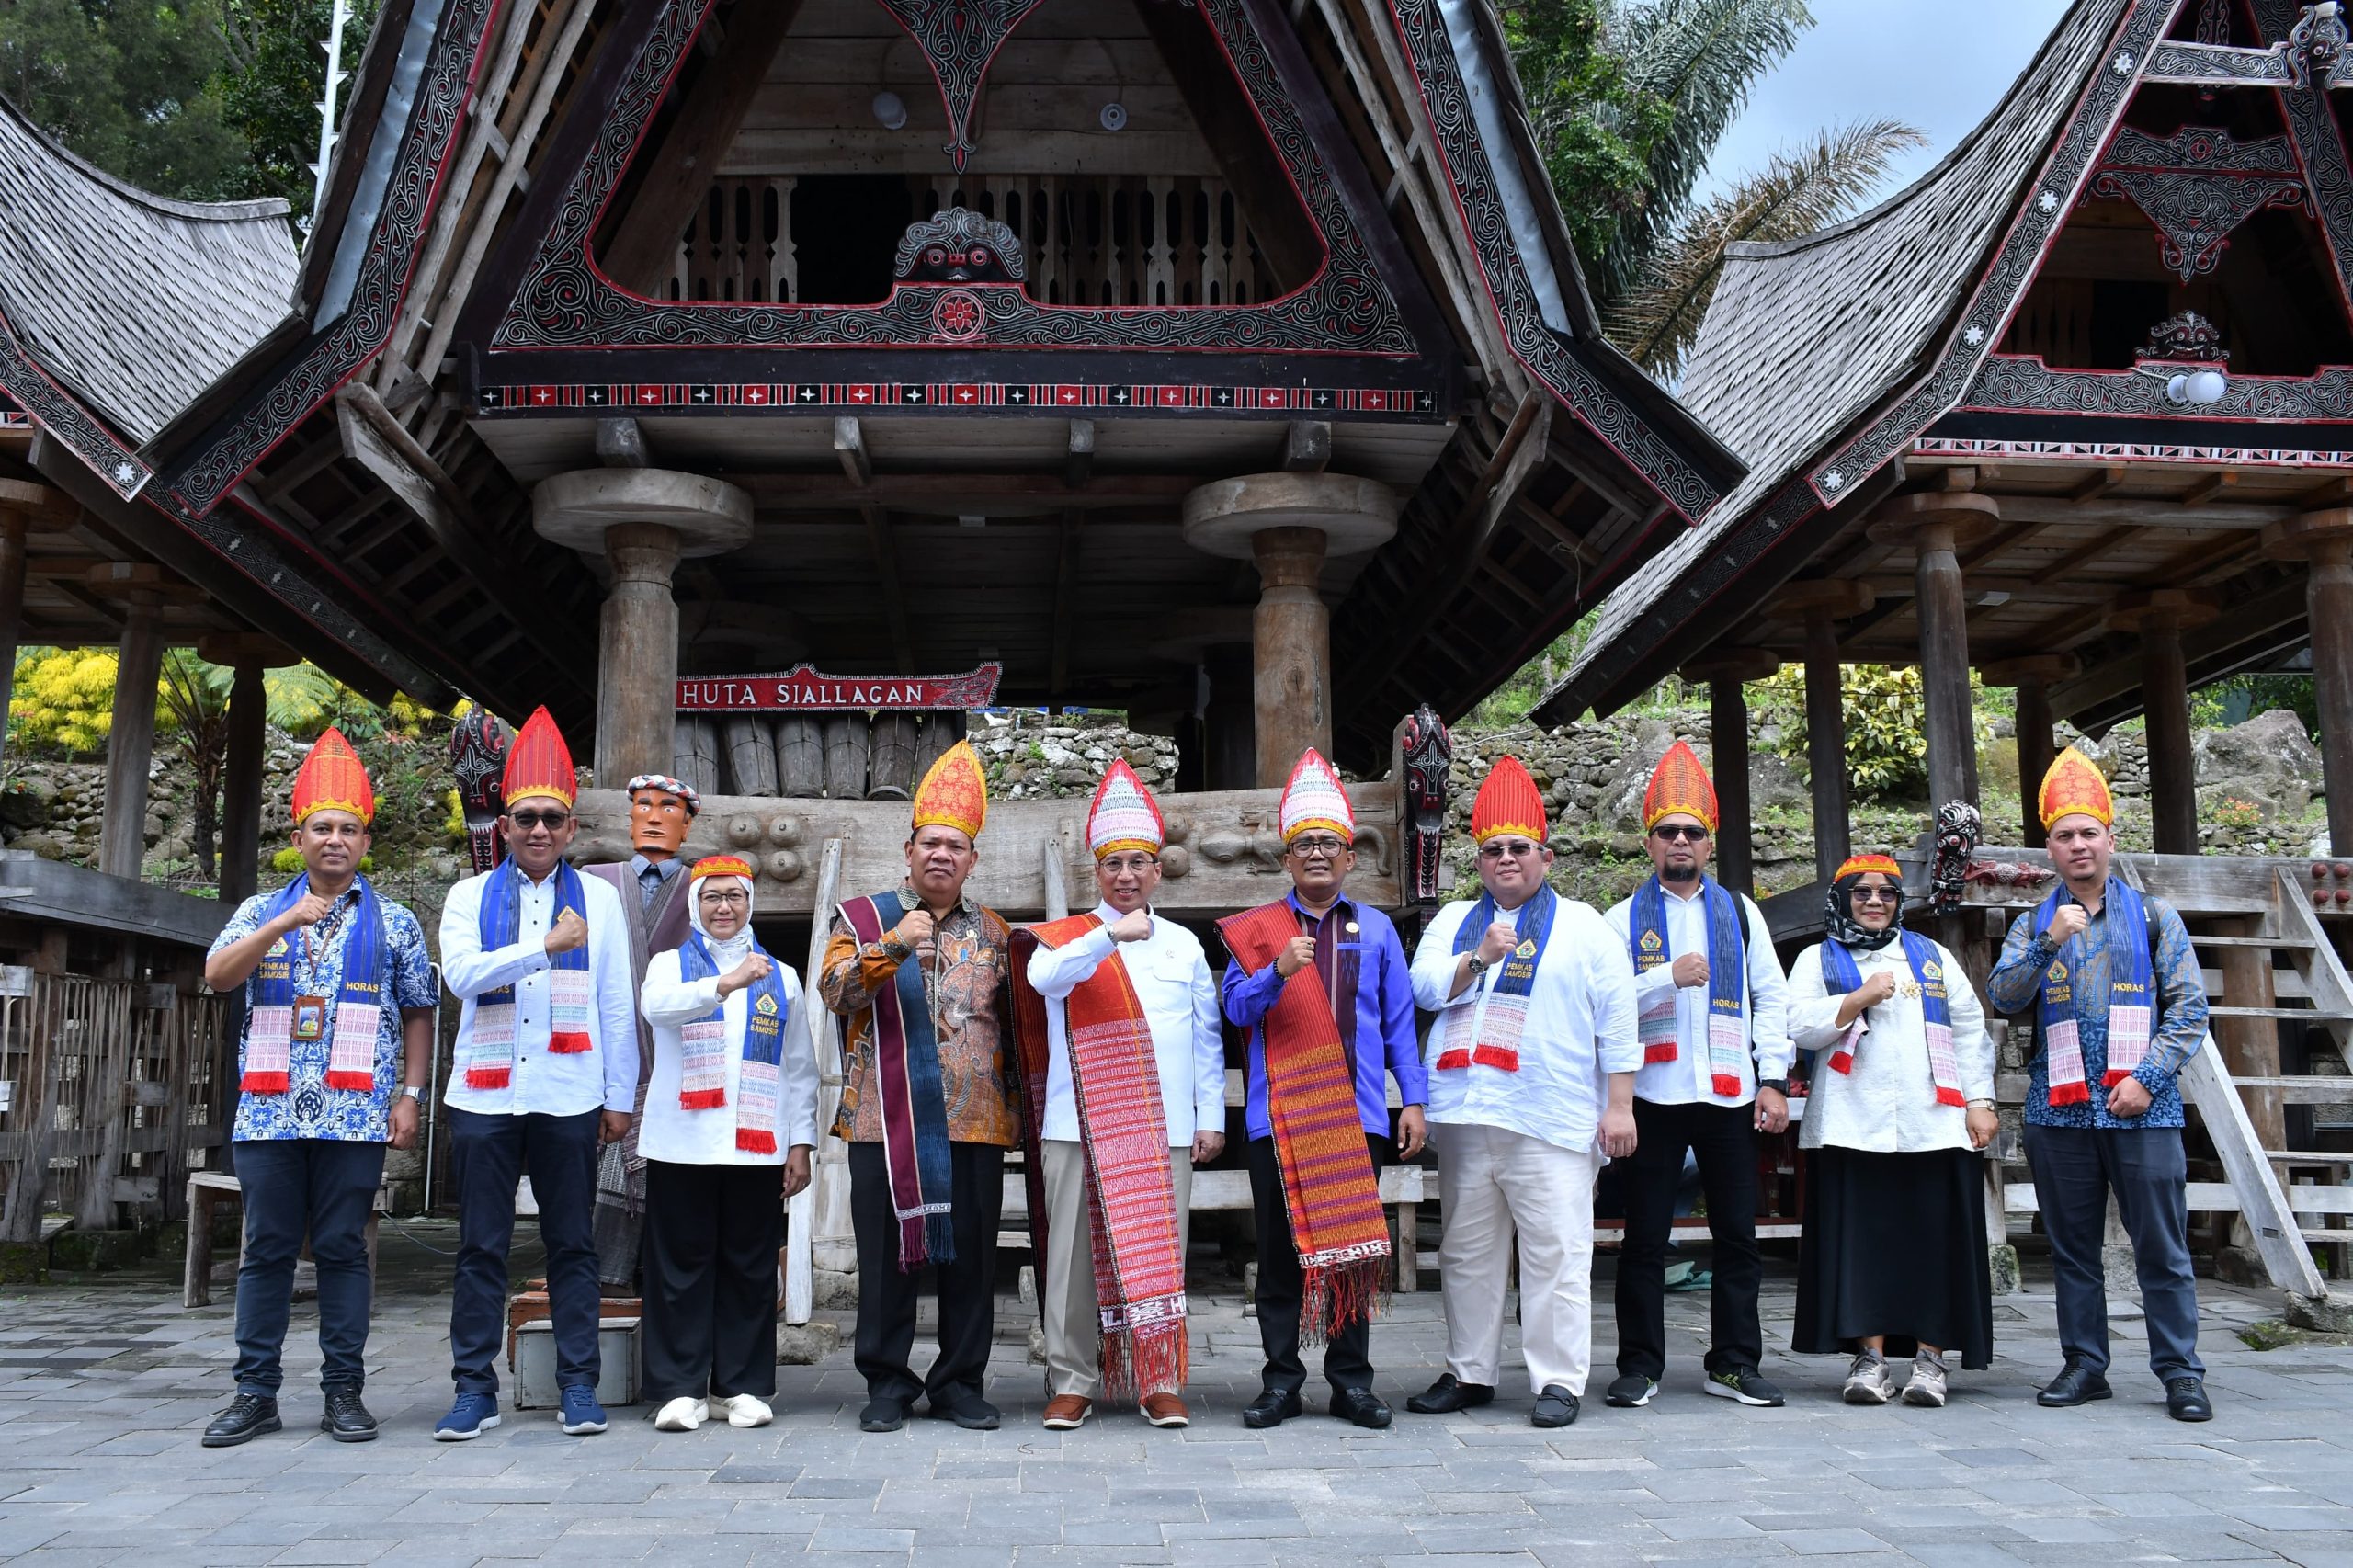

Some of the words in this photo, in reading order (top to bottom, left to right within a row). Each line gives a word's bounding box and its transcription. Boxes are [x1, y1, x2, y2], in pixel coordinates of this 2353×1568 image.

[682, 684, 757, 705] HUTA
[776, 684, 923, 704] SIALLAGAN
[1638, 955, 1665, 963] PEMKAB
[259, 962, 290, 971] PEMKAB
[1506, 962, 1533, 971] PEMKAB
[259, 971, 290, 979] SAMOSIR
[1504, 970, 1532, 979] SAMOSIR
[346, 982, 379, 993] HORAS
[2046, 985, 2070, 995] PEMKAB
[2113, 983, 2144, 993] HORAS
[1712, 998, 1740, 1009] HORAS
[752, 1016, 779, 1028] PEMKAB
[750, 1024, 779, 1036] SAMOSIR
